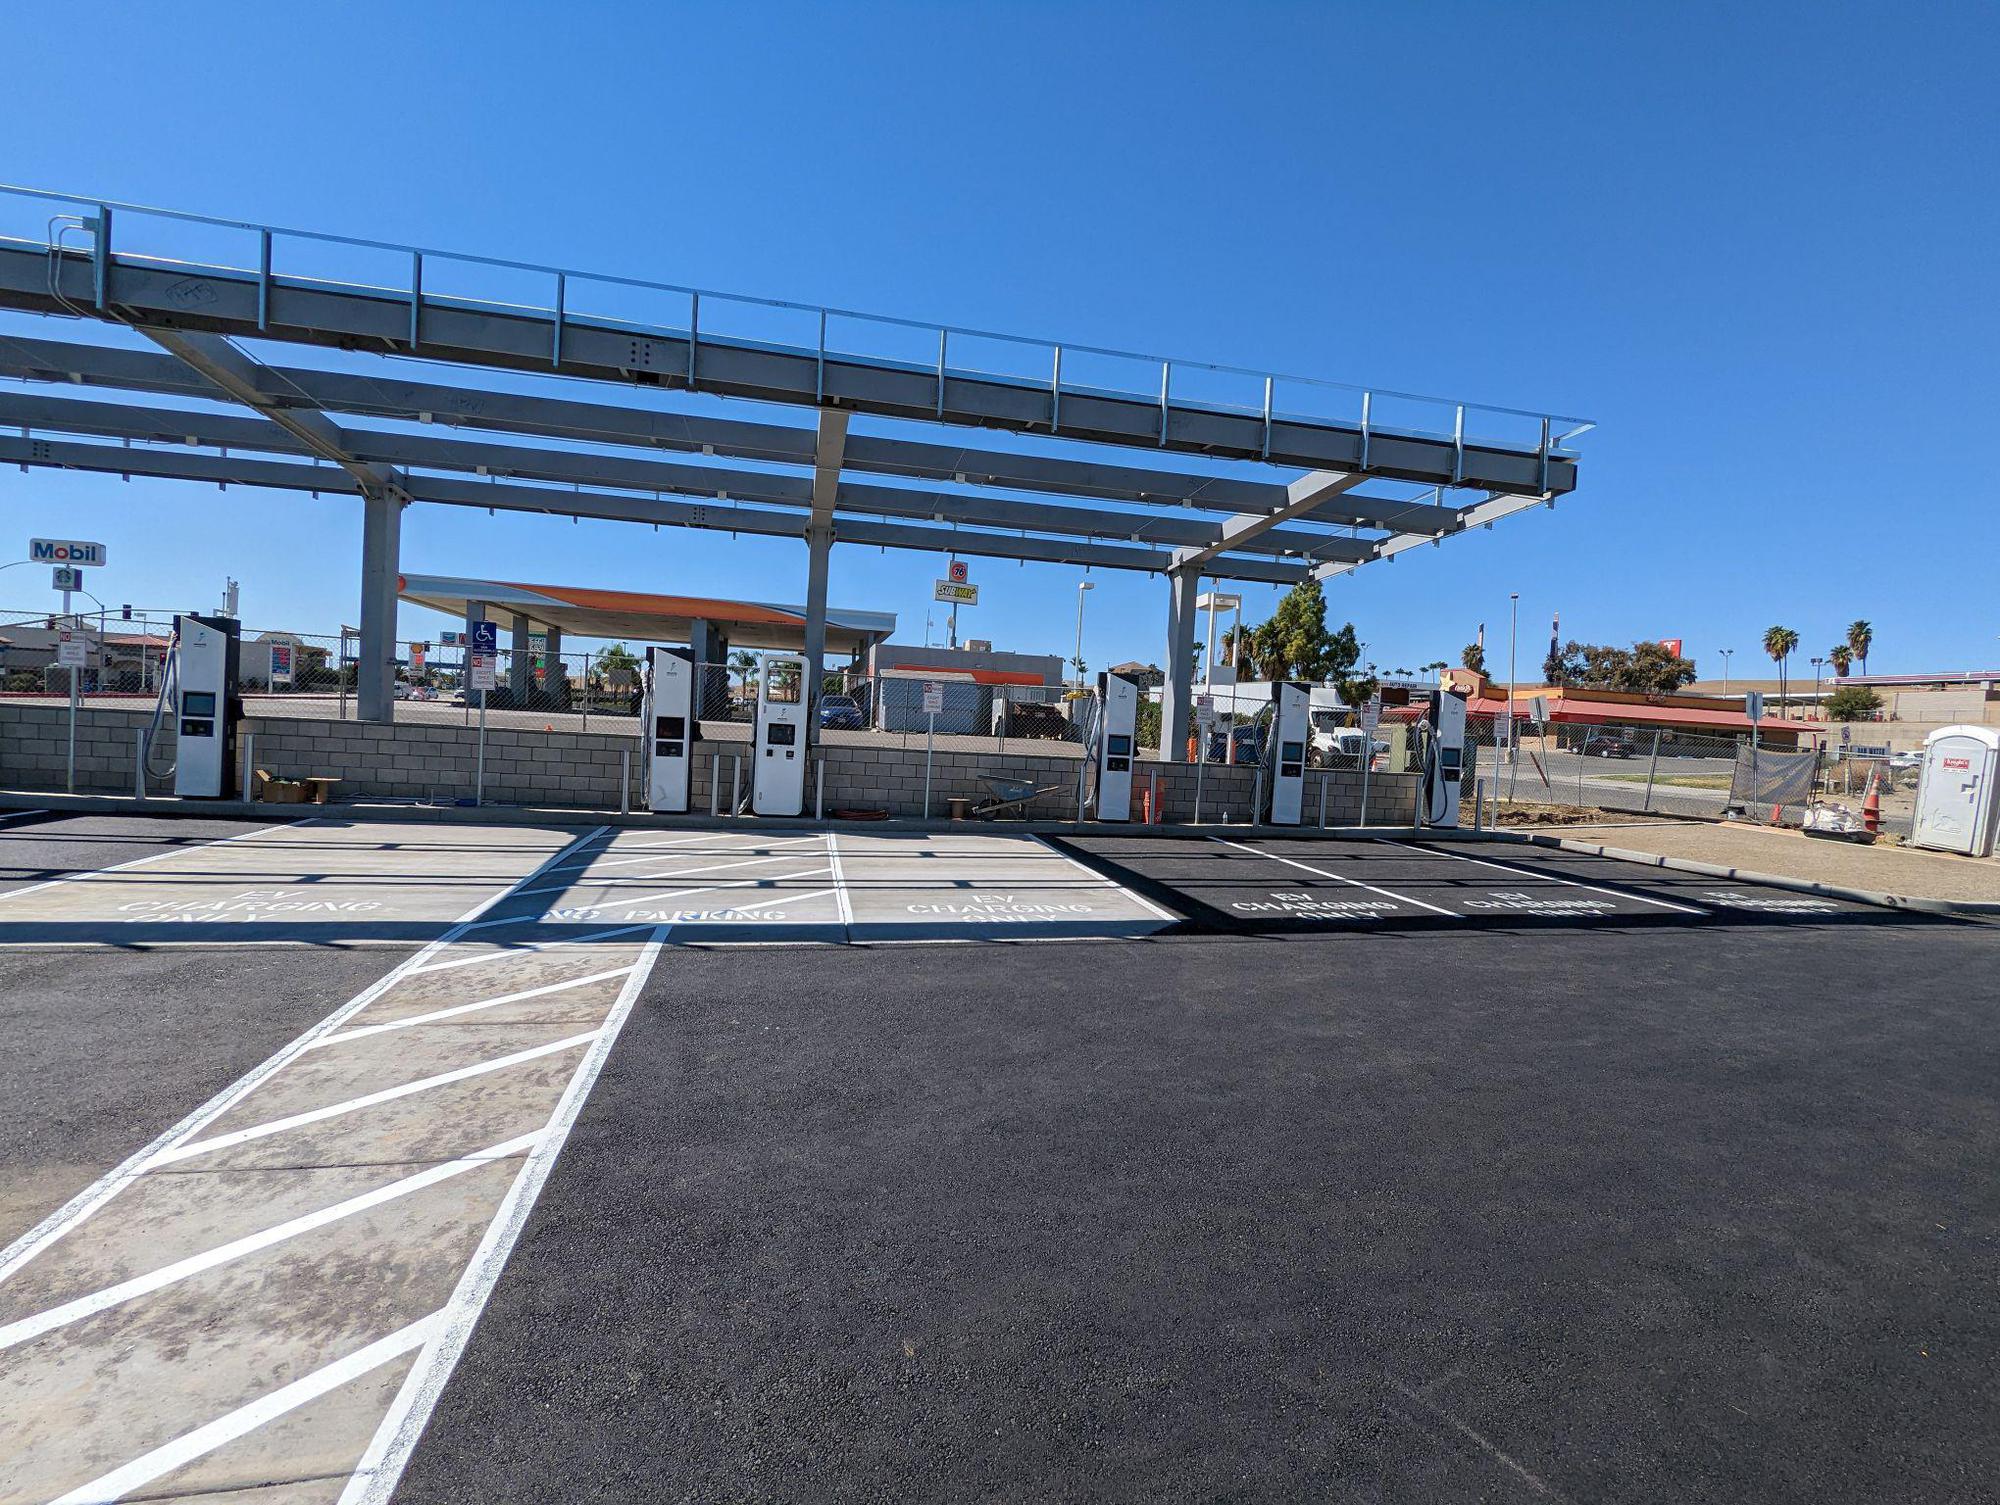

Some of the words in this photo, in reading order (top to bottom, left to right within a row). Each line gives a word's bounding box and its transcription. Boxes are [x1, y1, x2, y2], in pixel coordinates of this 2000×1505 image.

[34, 542, 96, 561] Mobil
[937, 585, 977, 599] SUBWAY
[232, 890, 307, 900] EV
[972, 894, 1014, 903] EV
[117, 901, 382, 911] CHARGING
[907, 904, 1093, 914] CHARGING
[540, 908, 601, 921] NO
[623, 908, 788, 922] PARKING
